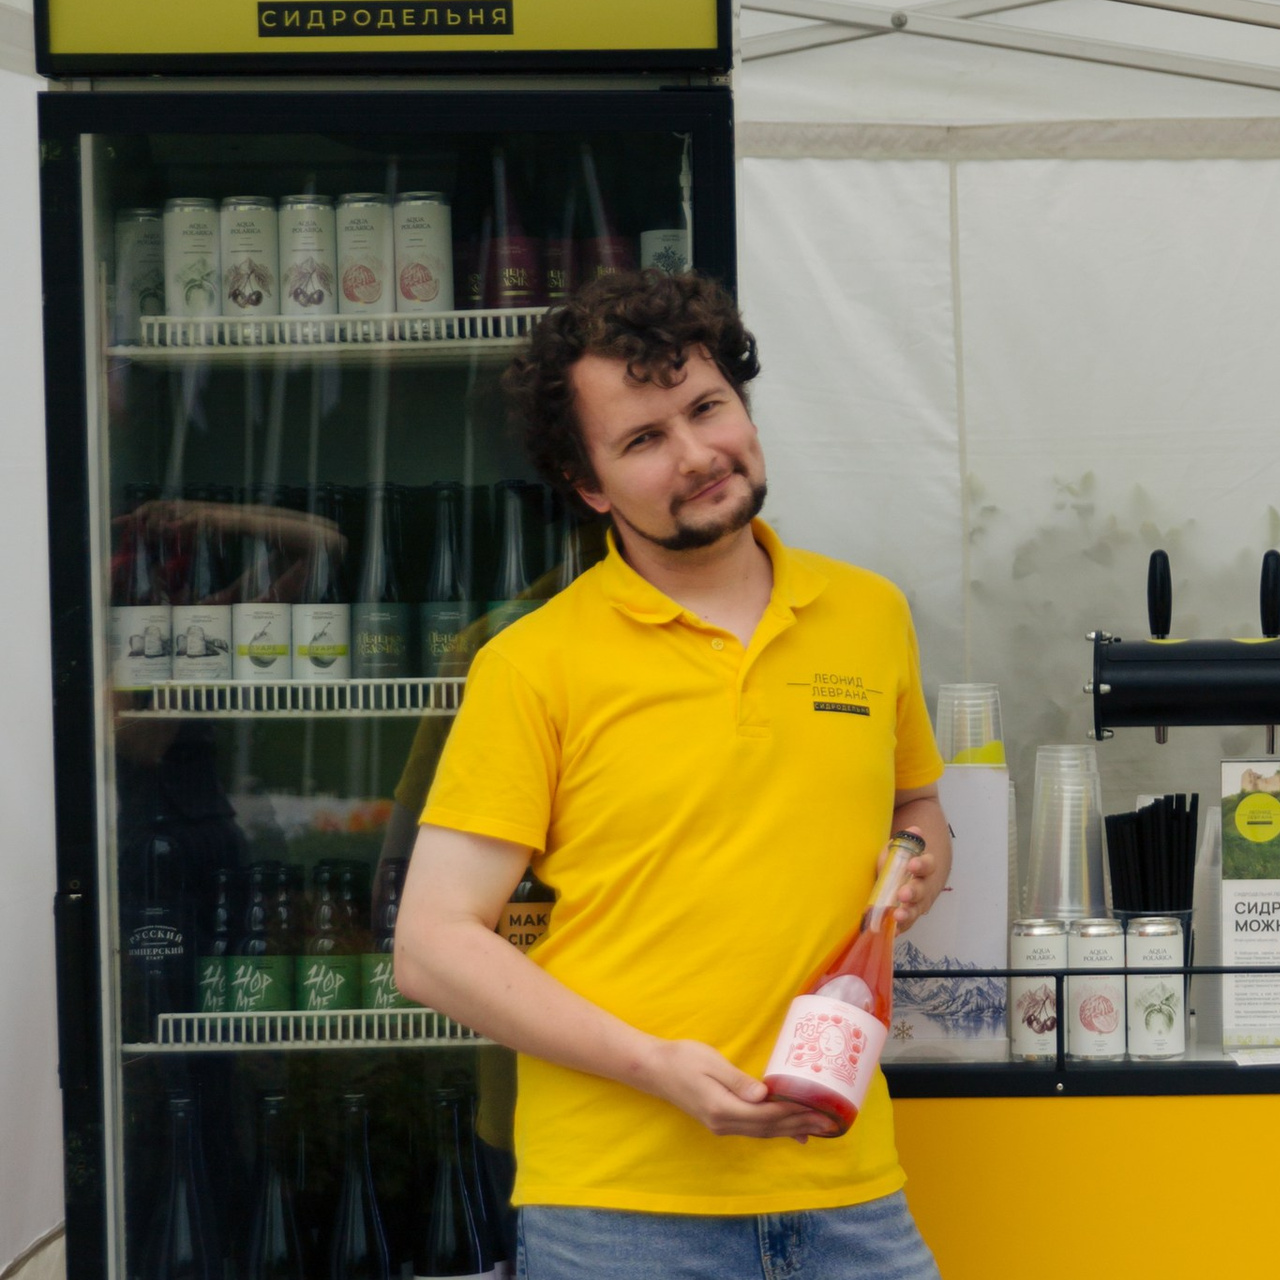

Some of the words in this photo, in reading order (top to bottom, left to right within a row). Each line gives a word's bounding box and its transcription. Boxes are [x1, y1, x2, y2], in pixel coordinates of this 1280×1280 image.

[260, 7, 507, 30] СИДРОДЕЛЬНЯ
[814, 673, 864, 689] ЛЕОНИД
[812, 686, 869, 701] ЛЕВРАНА
[509, 913, 548, 927] MAK
[128, 930, 184, 944] РУССКИЙ
[794, 1021, 824, 1038] РОЗЕ
